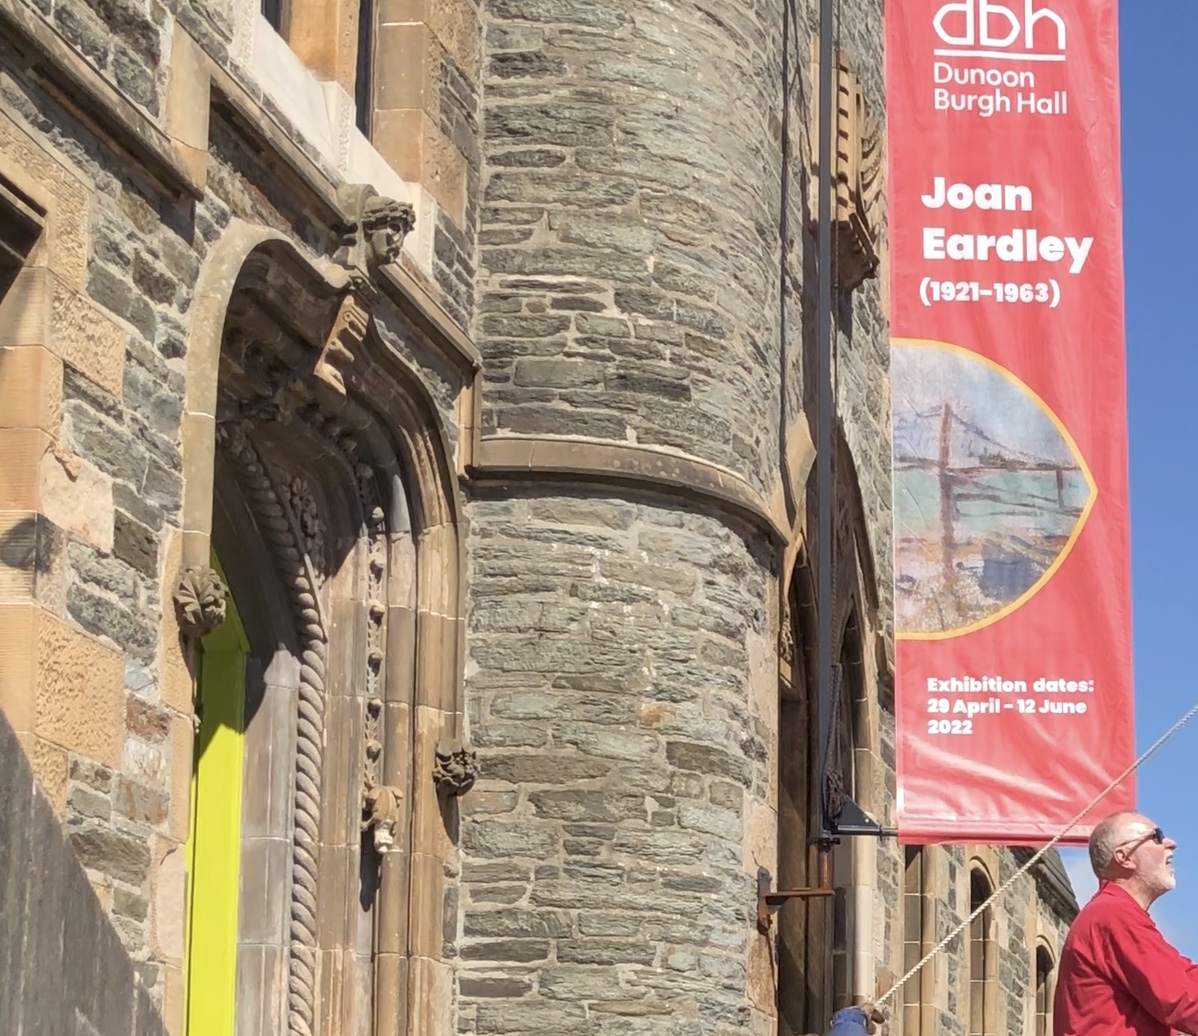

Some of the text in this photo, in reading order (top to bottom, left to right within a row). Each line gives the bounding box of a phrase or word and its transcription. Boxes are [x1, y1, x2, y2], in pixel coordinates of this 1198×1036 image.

[933, 62, 1034, 88] Dunoon
[934, 88, 1068, 117] Burgh Hall
[921, 177, 1032, 211] Joan
[922, 227, 1094, 274] Eardley
[927, 676, 1094, 693] Exhibition dates:
[927, 698, 950, 714] 29
[952, 697, 1001, 718] April
[1016, 699, 1036, 714] 12
[1039, 699, 1087, 714] June
[927, 719, 973, 734] 2022
